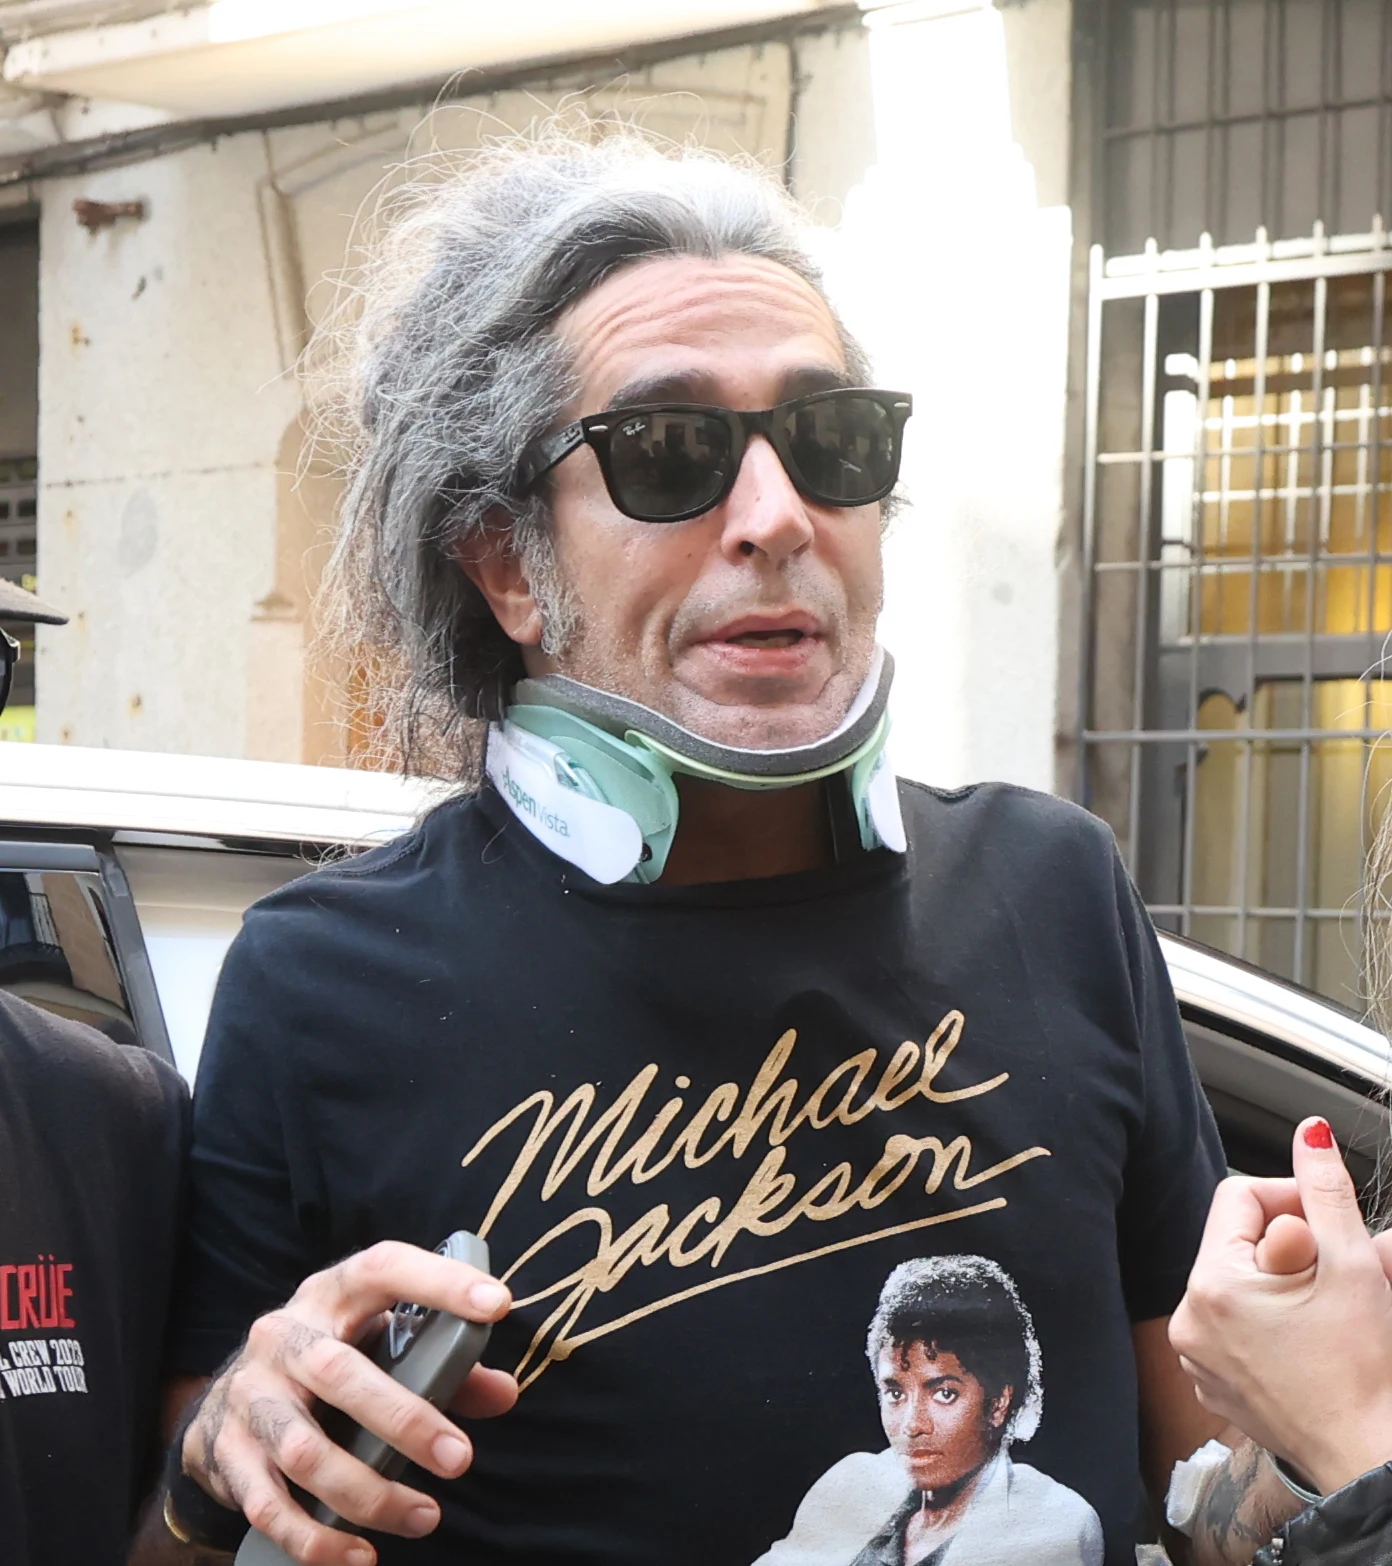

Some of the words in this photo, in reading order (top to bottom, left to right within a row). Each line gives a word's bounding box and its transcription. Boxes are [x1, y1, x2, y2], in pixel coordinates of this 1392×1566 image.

[461, 1009, 1009, 1240] Michael
[502, 1133, 1052, 1393] Jackson
[2, 1366, 57, 1398] WORLD
[53, 1365, 89, 1394] TOUR
[8, 1339, 51, 1368] CREW
